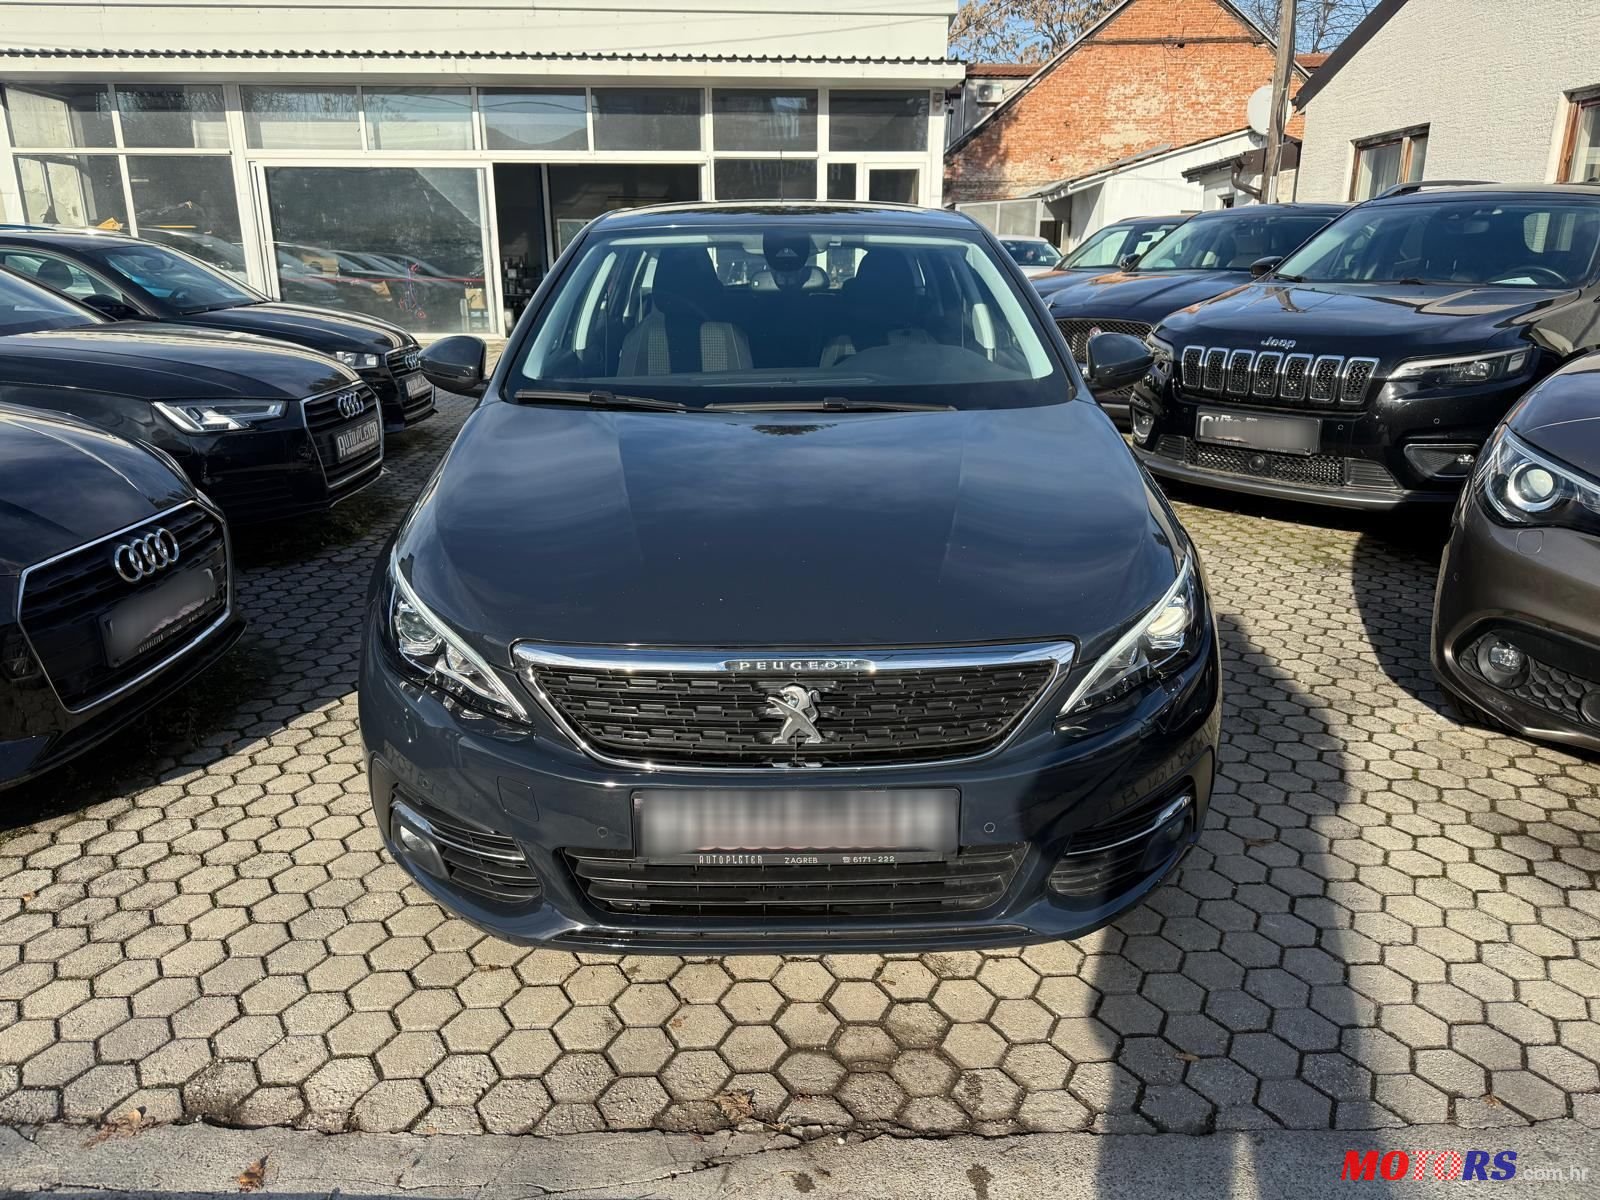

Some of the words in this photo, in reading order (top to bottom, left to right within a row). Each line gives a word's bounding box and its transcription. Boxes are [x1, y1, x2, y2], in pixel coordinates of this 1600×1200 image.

[1261, 336, 1297, 350] Jeep
[338, 421, 380, 457] AUTOPLETER
[739, 660, 855, 671] PEUGEOT
[699, 854, 764, 865] AUTOPLETER
[784, 856, 818, 865] ZAGREB
[852, 855, 896, 864] 6171-222
